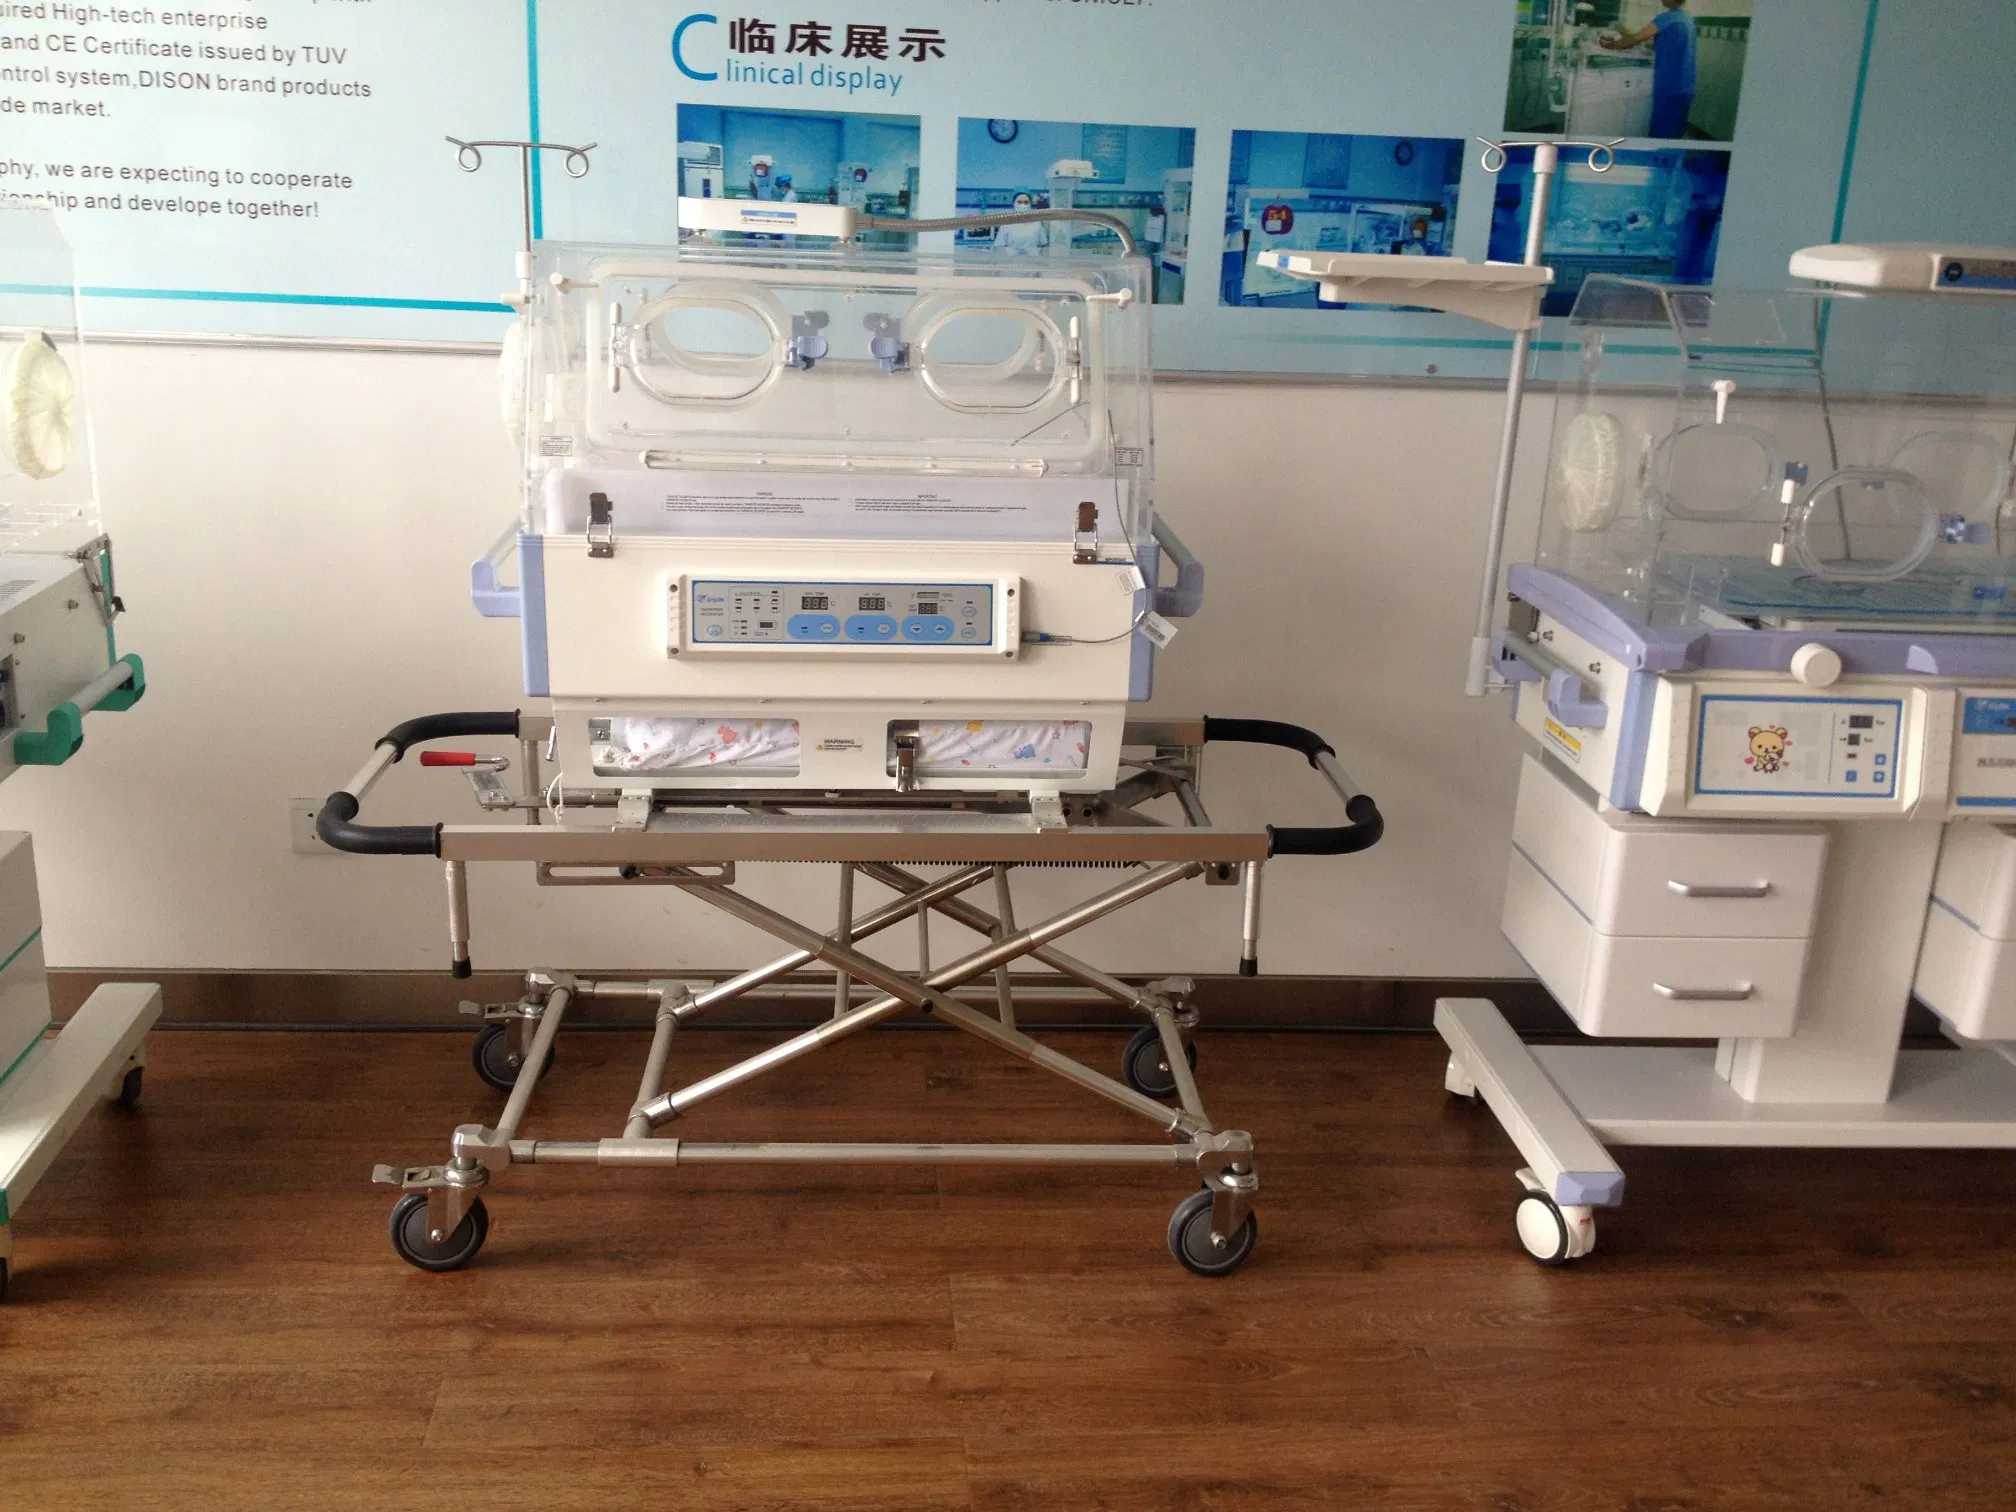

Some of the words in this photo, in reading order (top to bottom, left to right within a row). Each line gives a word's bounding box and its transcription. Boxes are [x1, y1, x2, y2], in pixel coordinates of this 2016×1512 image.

[52, 3, 155, 25] High-tech
[161, 10, 268, 31] enterprise
[1, 34, 40, 50] and
[45, 34, 77, 52] CE
[83, 36, 192, 58] Certificate
[198, 42, 266, 61] issued
[272, 45, 295, 67] by
[302, 46, 347, 64] TUV
[729, 18, 946, 62] 临床展示
[217, 73, 275, 93] brand
[282, 79, 371, 97] products
[810, 63, 902, 96] display
[0, 96, 26, 113] de
[32, 99, 111, 117] market.
[44, 164, 74, 177] we
[80, 165, 113, 179] are
[120, 166, 219, 187] expecting
[225, 169, 244, 184] to
[250, 172, 353, 190] cooperate
[84, 194, 121, 210] and
[128, 194, 221, 216] develope
[227, 198, 318, 219] together!
